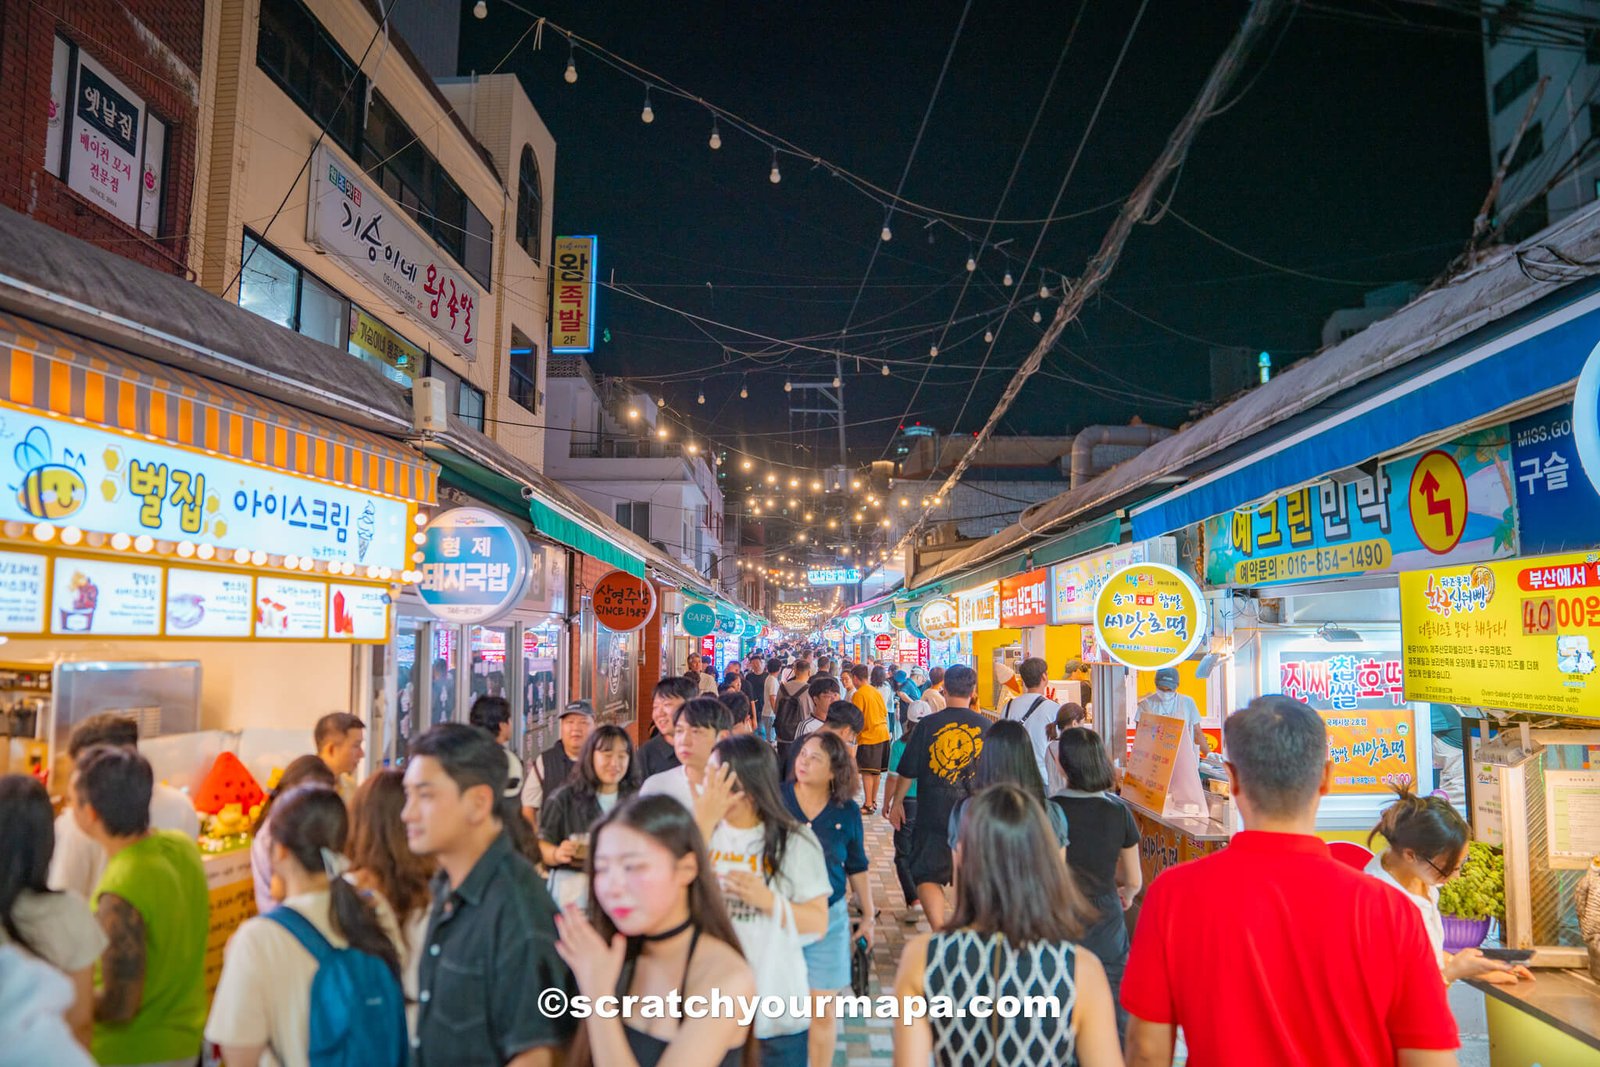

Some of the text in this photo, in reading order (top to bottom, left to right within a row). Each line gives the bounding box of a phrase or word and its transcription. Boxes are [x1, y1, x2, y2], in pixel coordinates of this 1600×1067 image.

[84, 86, 134, 141] 옛날집
[80, 131, 110, 165] 베이컨
[89, 162, 120, 194] 전문점
[341, 201, 474, 344] 기승이네 왕족발
[559, 253, 588, 333] 왕족발
[563, 335, 577, 345] 2F
[1519, 451, 1569, 495] 구슬
[129, 459, 350, 543] 벌집 아이스크림
[1320, 465, 1392, 534] 민박
[420, 562, 510, 592] 돼지국밥
[1240, 557, 1278, 583] 예약문의
[1287, 543, 1383, 576] 016-854-1490
[1529, 566, 1587, 589] 부산에서
[1158, 592, 1184, 610] 찹쌀
[687, 612, 712, 624] CAFE
[1103, 611, 1188, 641] 씨앗호떡
[1511, 691, 1523, 701] gold
[1547, 693, 1565, 703] bread
[1528, 701, 1559, 712] produced
[1566, 704, 1579, 714] Jeju
[1352, 738, 1406, 766] 씨앗호떡
